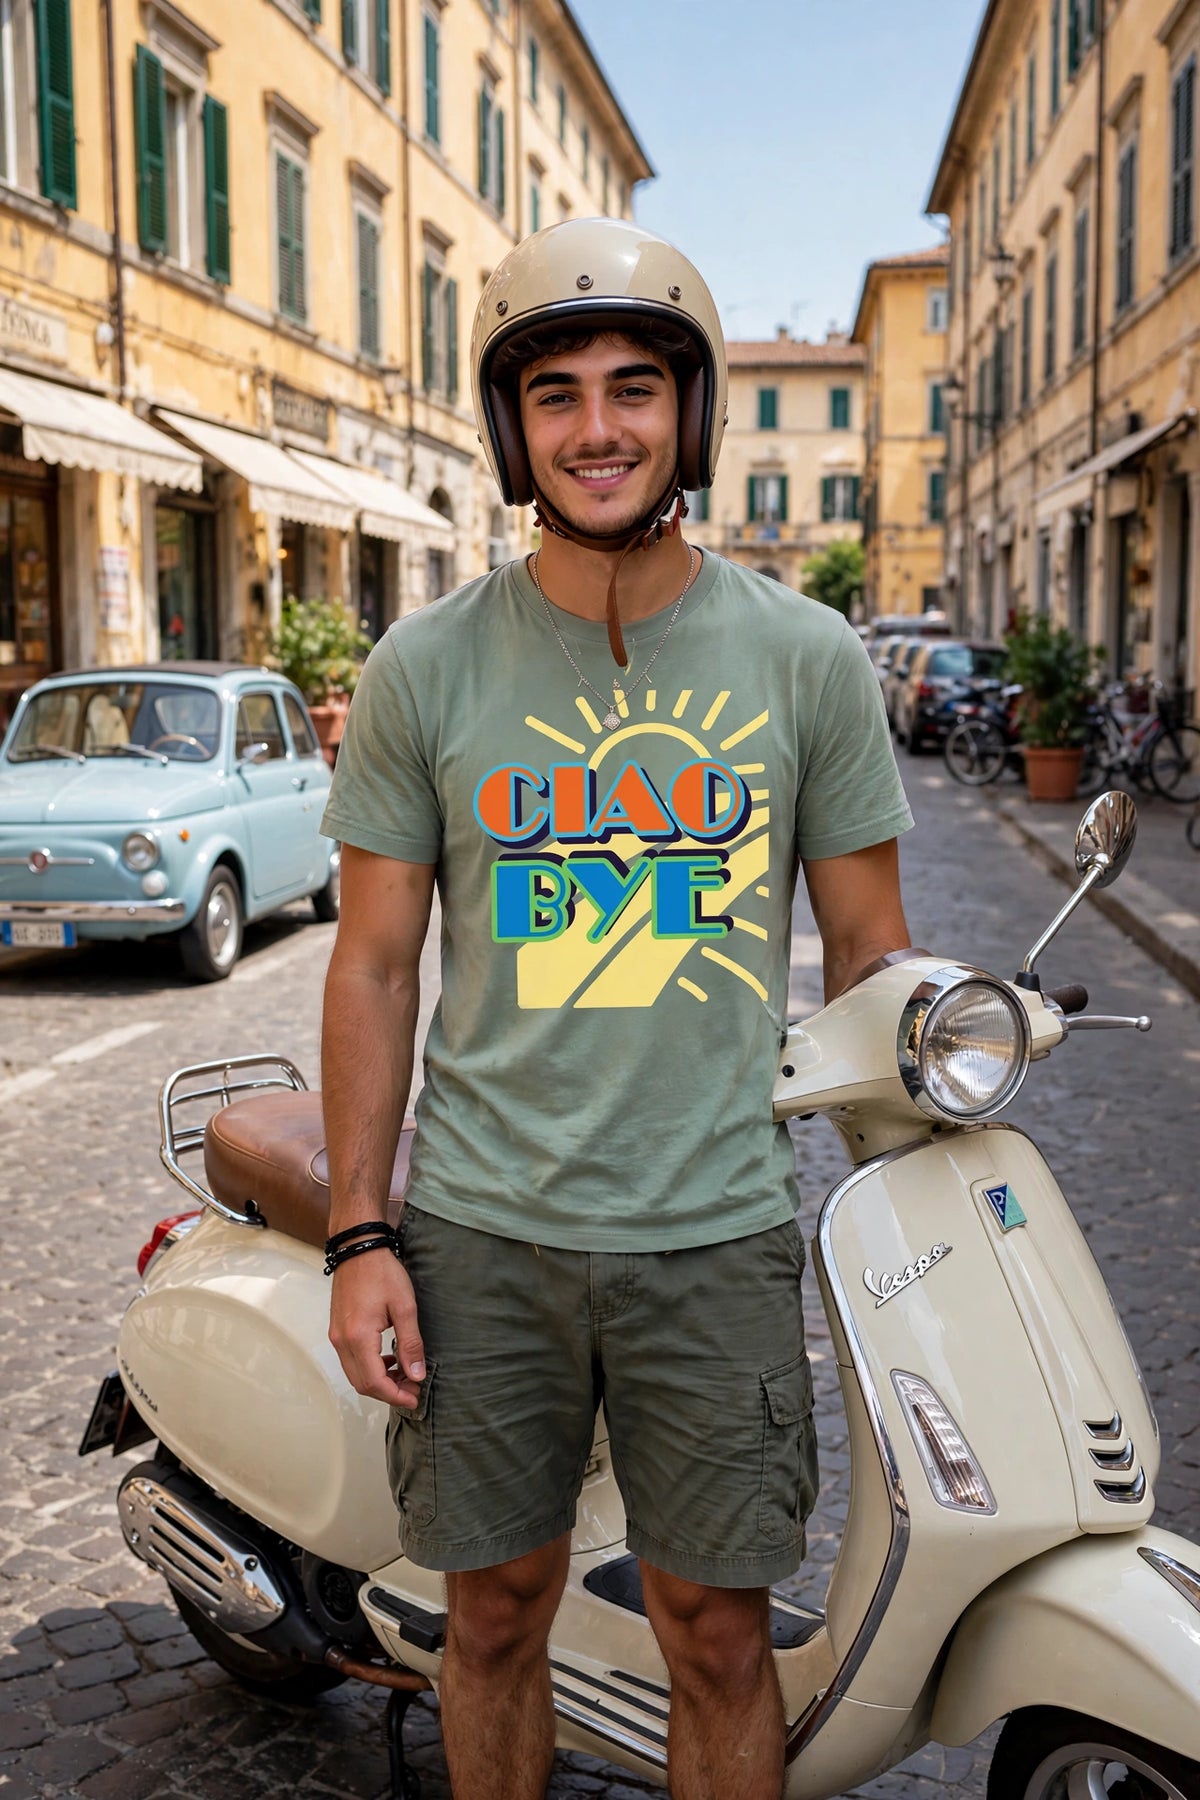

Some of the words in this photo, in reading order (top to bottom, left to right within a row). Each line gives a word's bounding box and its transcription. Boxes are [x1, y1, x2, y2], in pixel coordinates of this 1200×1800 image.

[473, 757, 752, 848] CIAO
[491, 850, 733, 944] BYE
[863, 1242, 953, 1309] Vespa
